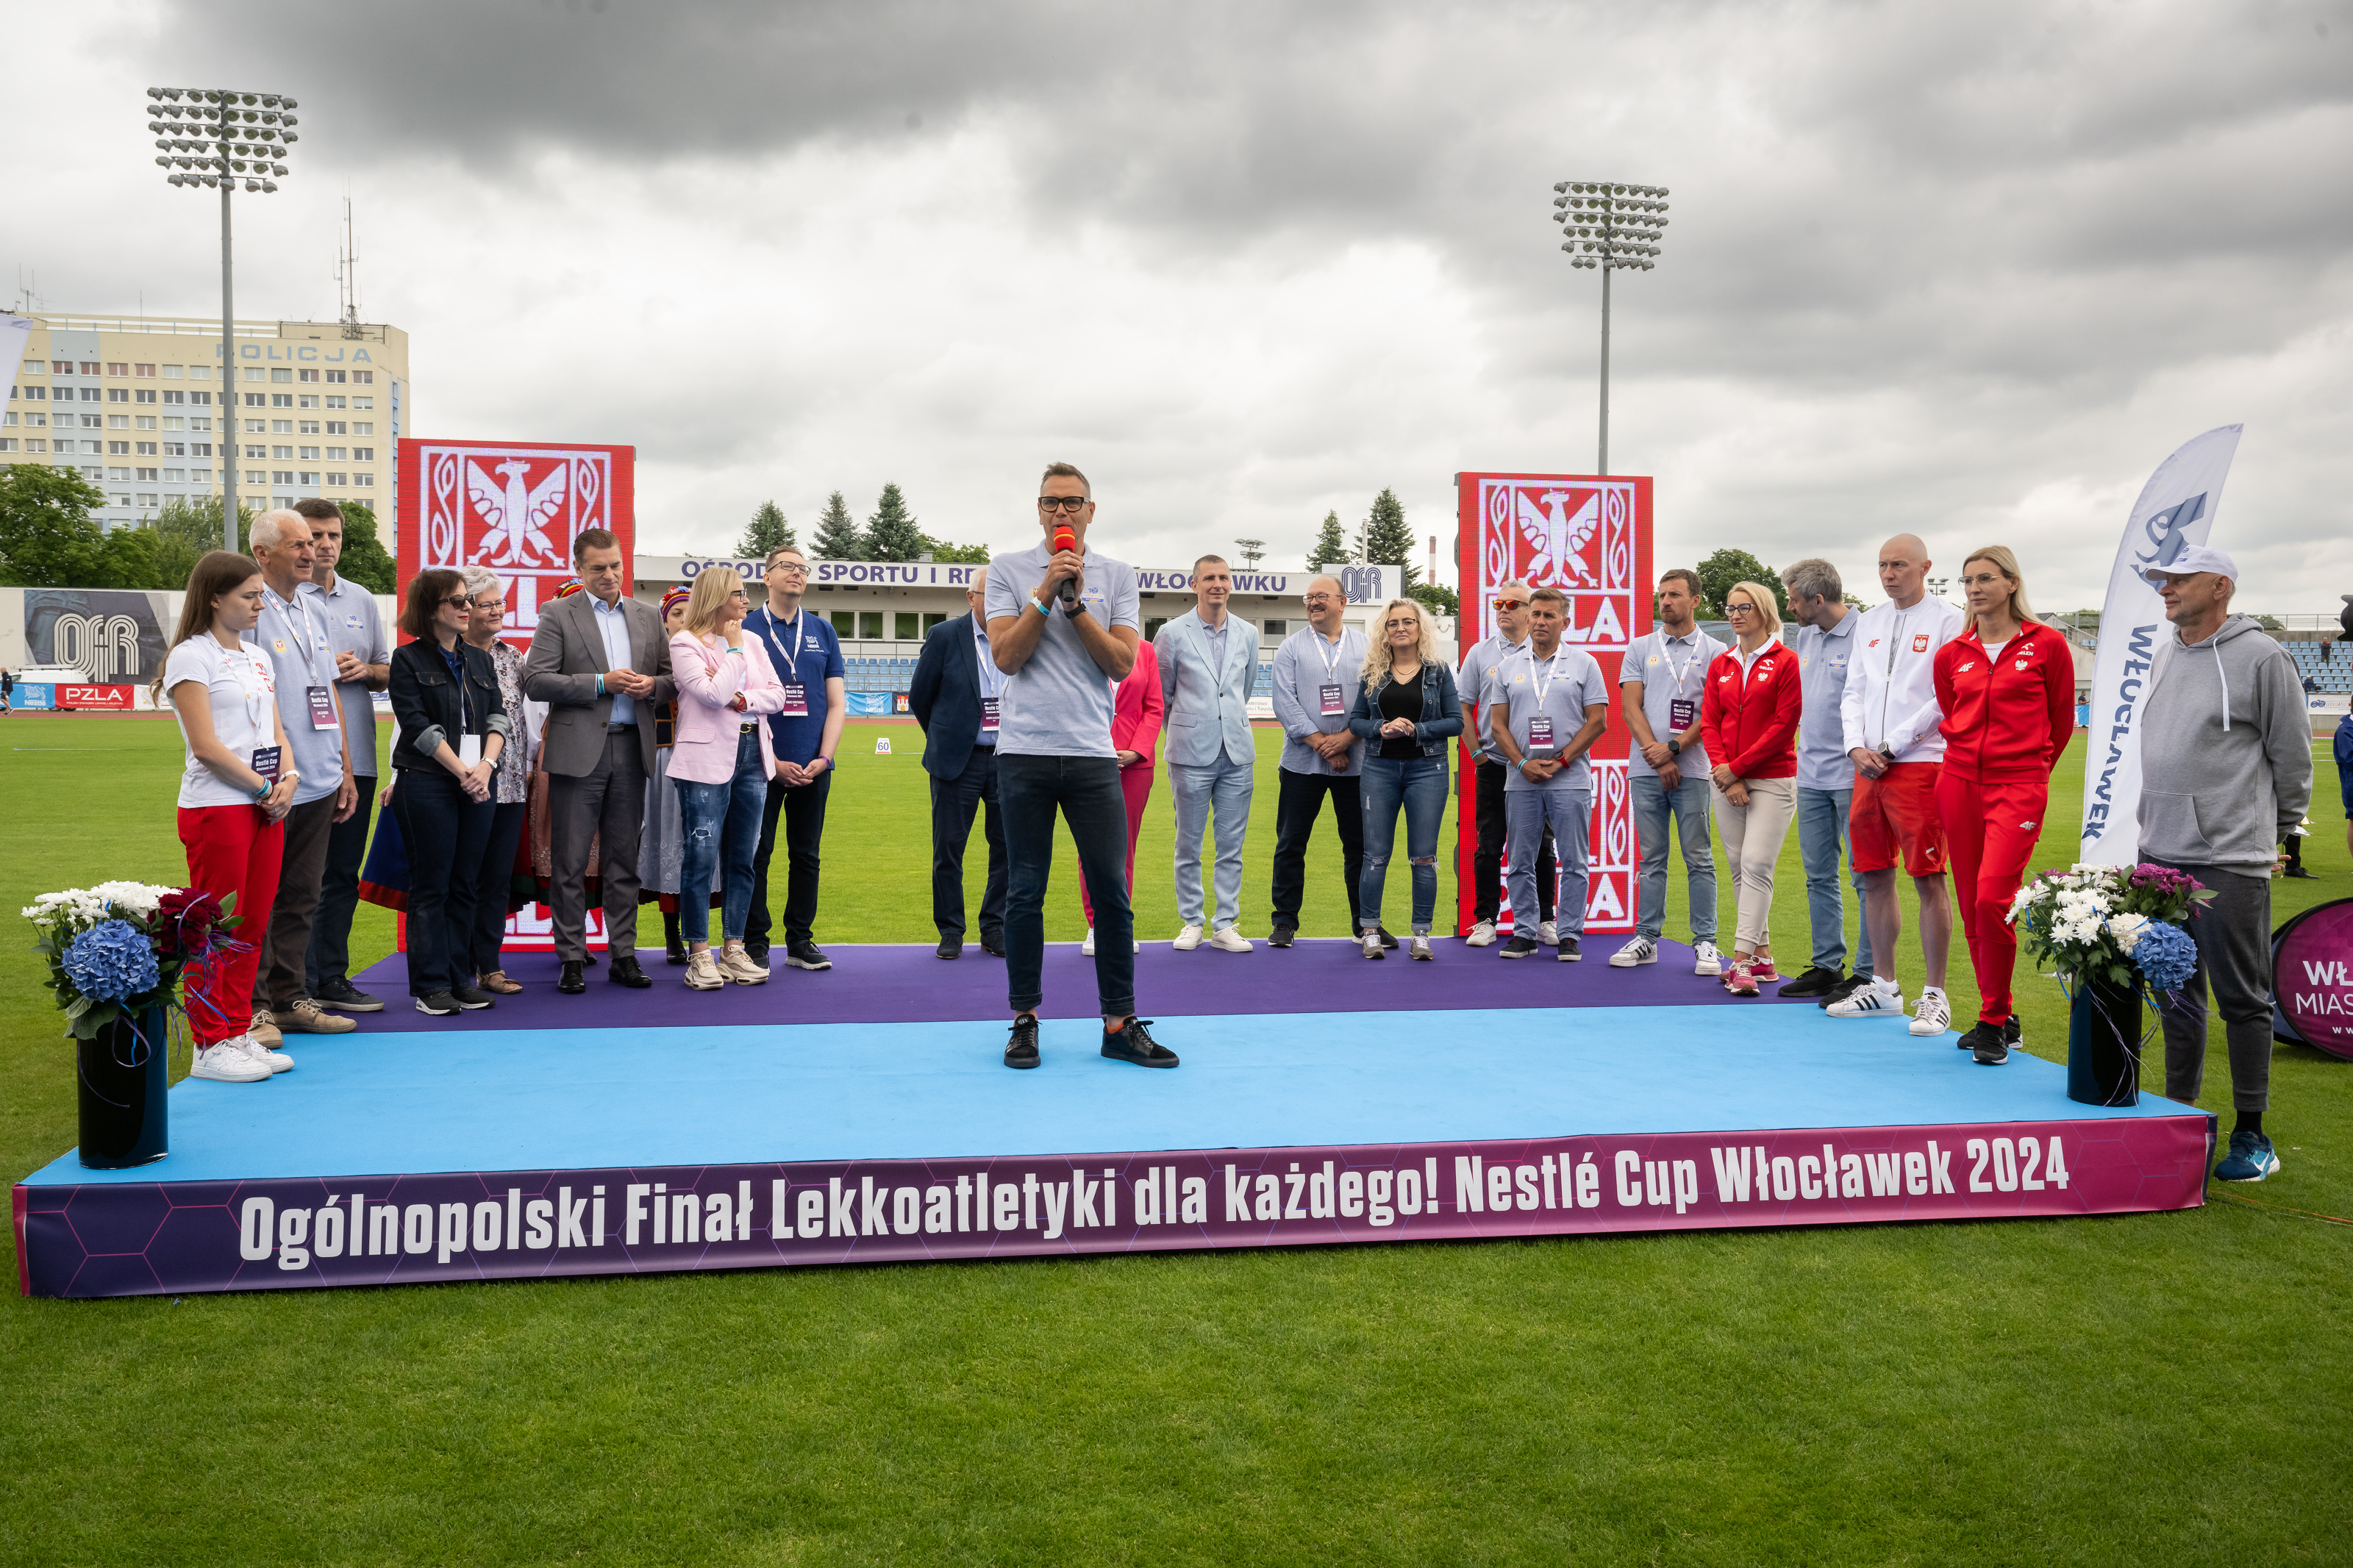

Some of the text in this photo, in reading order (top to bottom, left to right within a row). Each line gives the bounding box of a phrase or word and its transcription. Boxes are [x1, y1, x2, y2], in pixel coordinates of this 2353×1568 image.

[818, 564, 918, 583] SPORTU
[930, 567, 936, 584] I
[1958, 662, 1975, 673] 4F
[66, 688, 123, 701] PZLA
[2081, 623, 2159, 840] WŁOCŁAWEK
[877, 742, 889, 751] 60
[2019, 820, 2038, 831] 4F
[2302, 961, 2353, 986] WŁ
[2296, 993, 2353, 1015] MIAS
[240, 1136, 2069, 1270] Ogólnopolski Finał Lekkoatletyki dla każdego! Nestlé Cup Włocławek 2024
